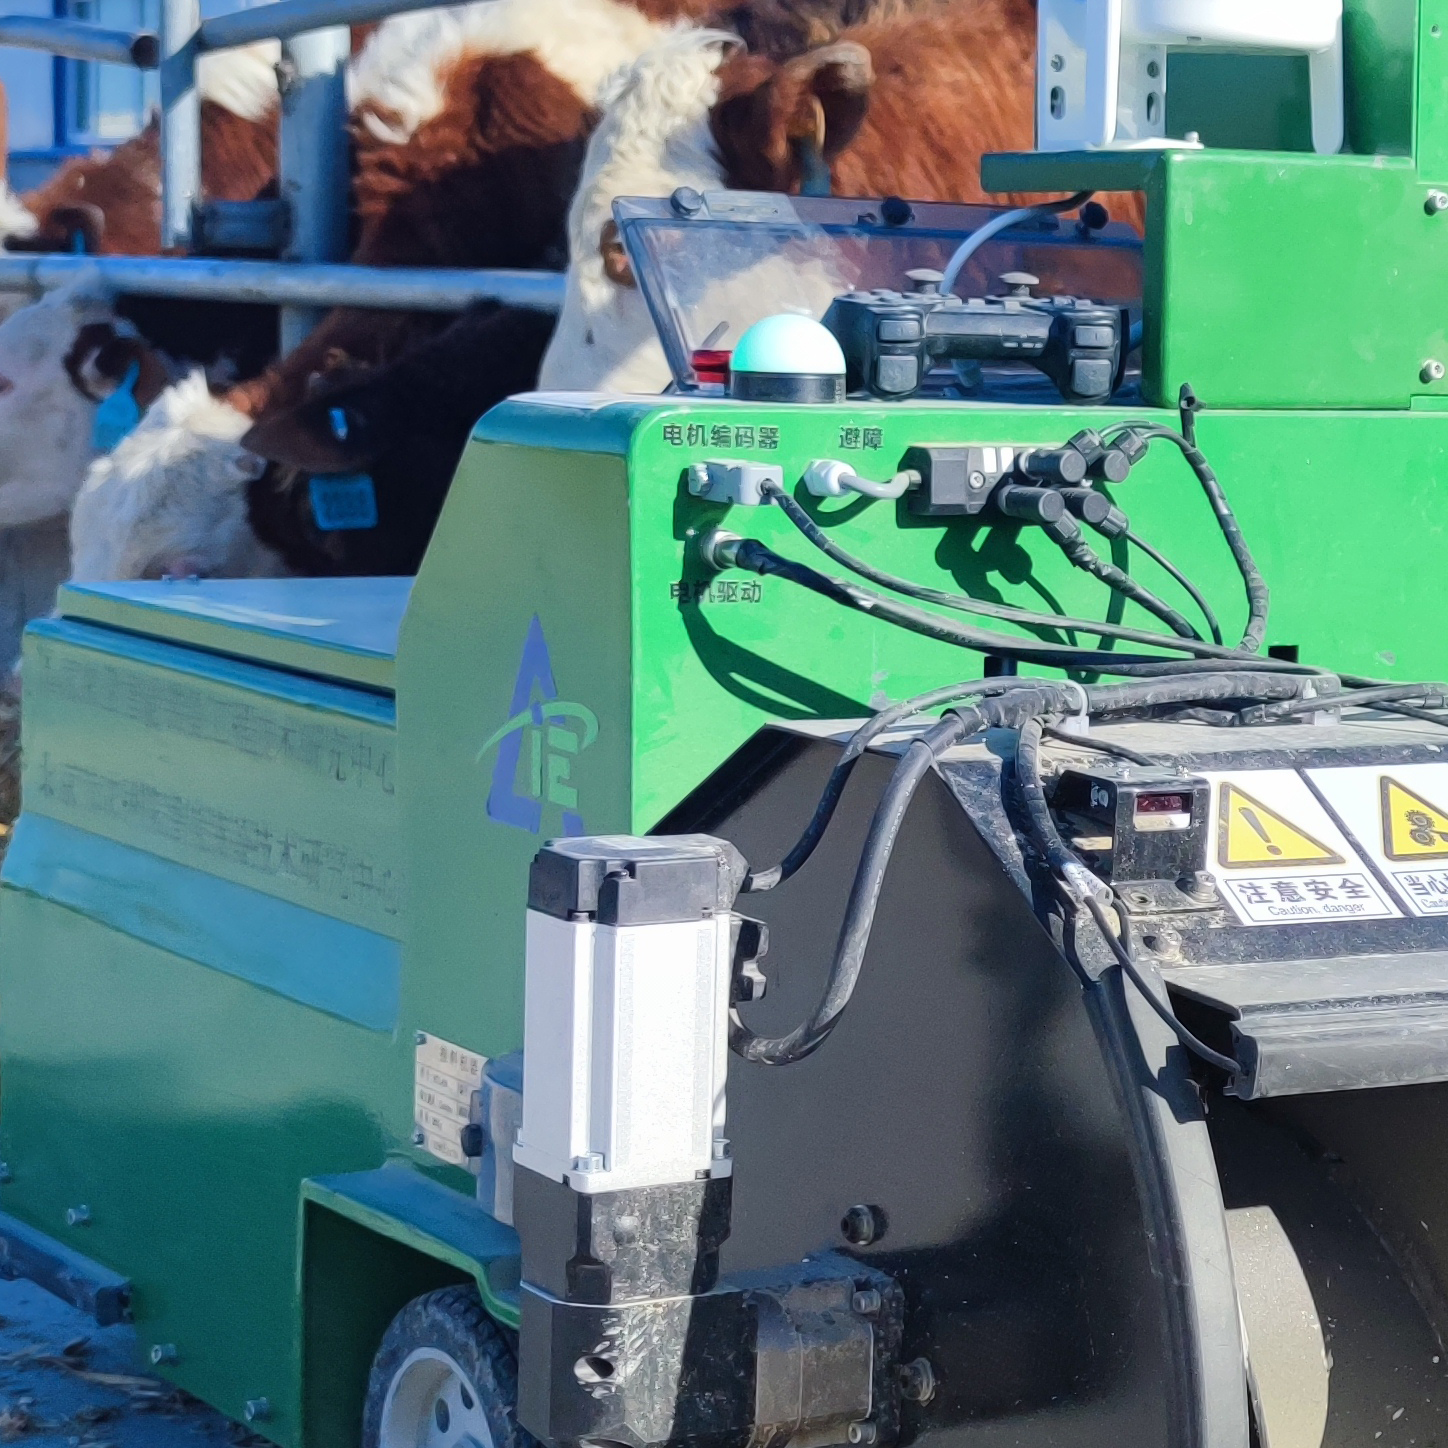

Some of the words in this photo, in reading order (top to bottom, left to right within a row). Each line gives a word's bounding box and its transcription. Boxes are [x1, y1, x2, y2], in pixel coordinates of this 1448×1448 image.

[662, 423, 780, 450] 电机编码器
[838, 426, 884, 451] 避障
[669, 580, 762, 604] 电机驱动
[1238, 878, 1373, 905] 注意安全
[1323, 902, 1366, 915] danger
